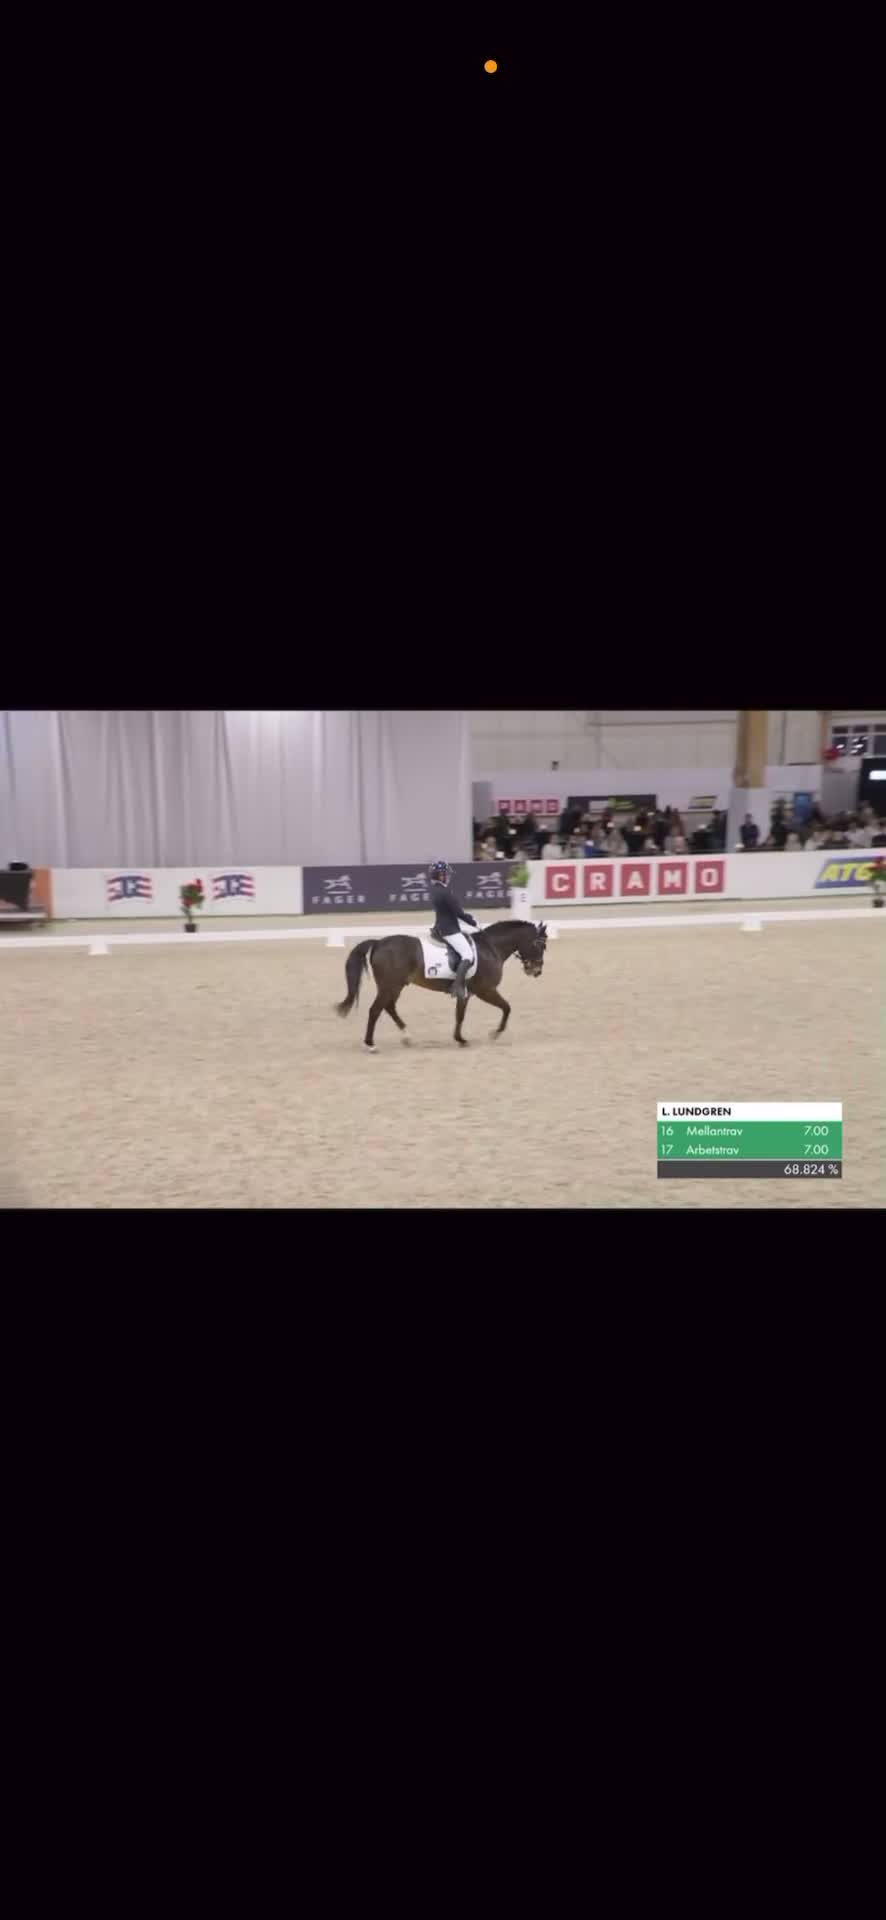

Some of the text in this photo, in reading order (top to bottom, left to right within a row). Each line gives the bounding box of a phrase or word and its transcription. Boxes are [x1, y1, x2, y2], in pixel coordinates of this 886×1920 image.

[551, 867, 719, 892] CRAMO
[311, 895, 366, 905] FAGER
[389, 893, 430, 902] FAGE
